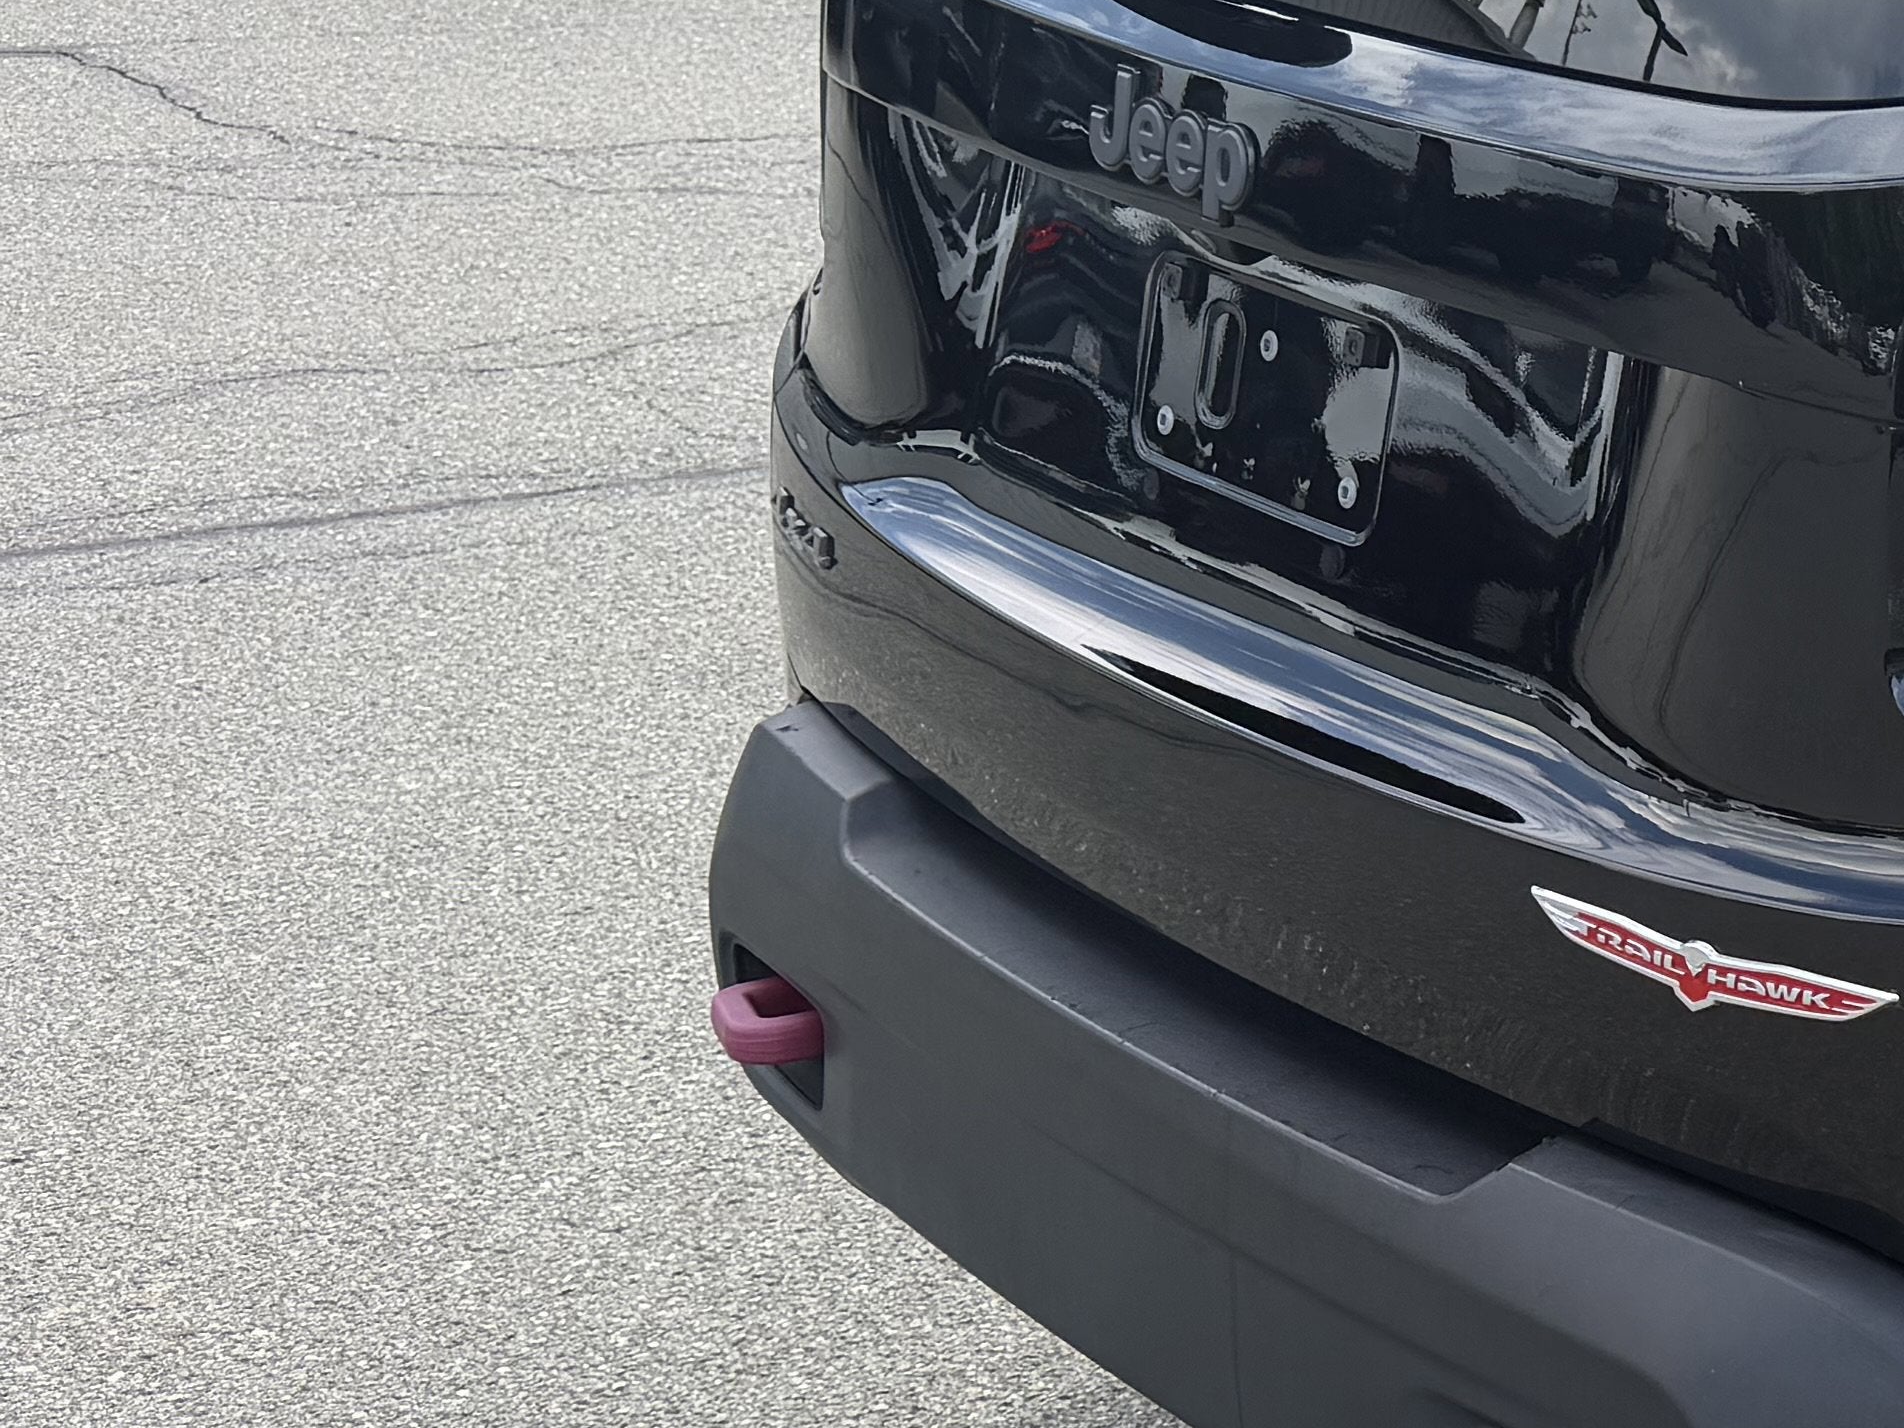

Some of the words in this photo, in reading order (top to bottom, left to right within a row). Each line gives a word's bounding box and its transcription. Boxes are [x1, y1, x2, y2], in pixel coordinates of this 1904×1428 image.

[1088, 62, 1258, 224] Jeep
[1573, 920, 1686, 976] TRAIL
[1707, 967, 1831, 1011] HAWK
